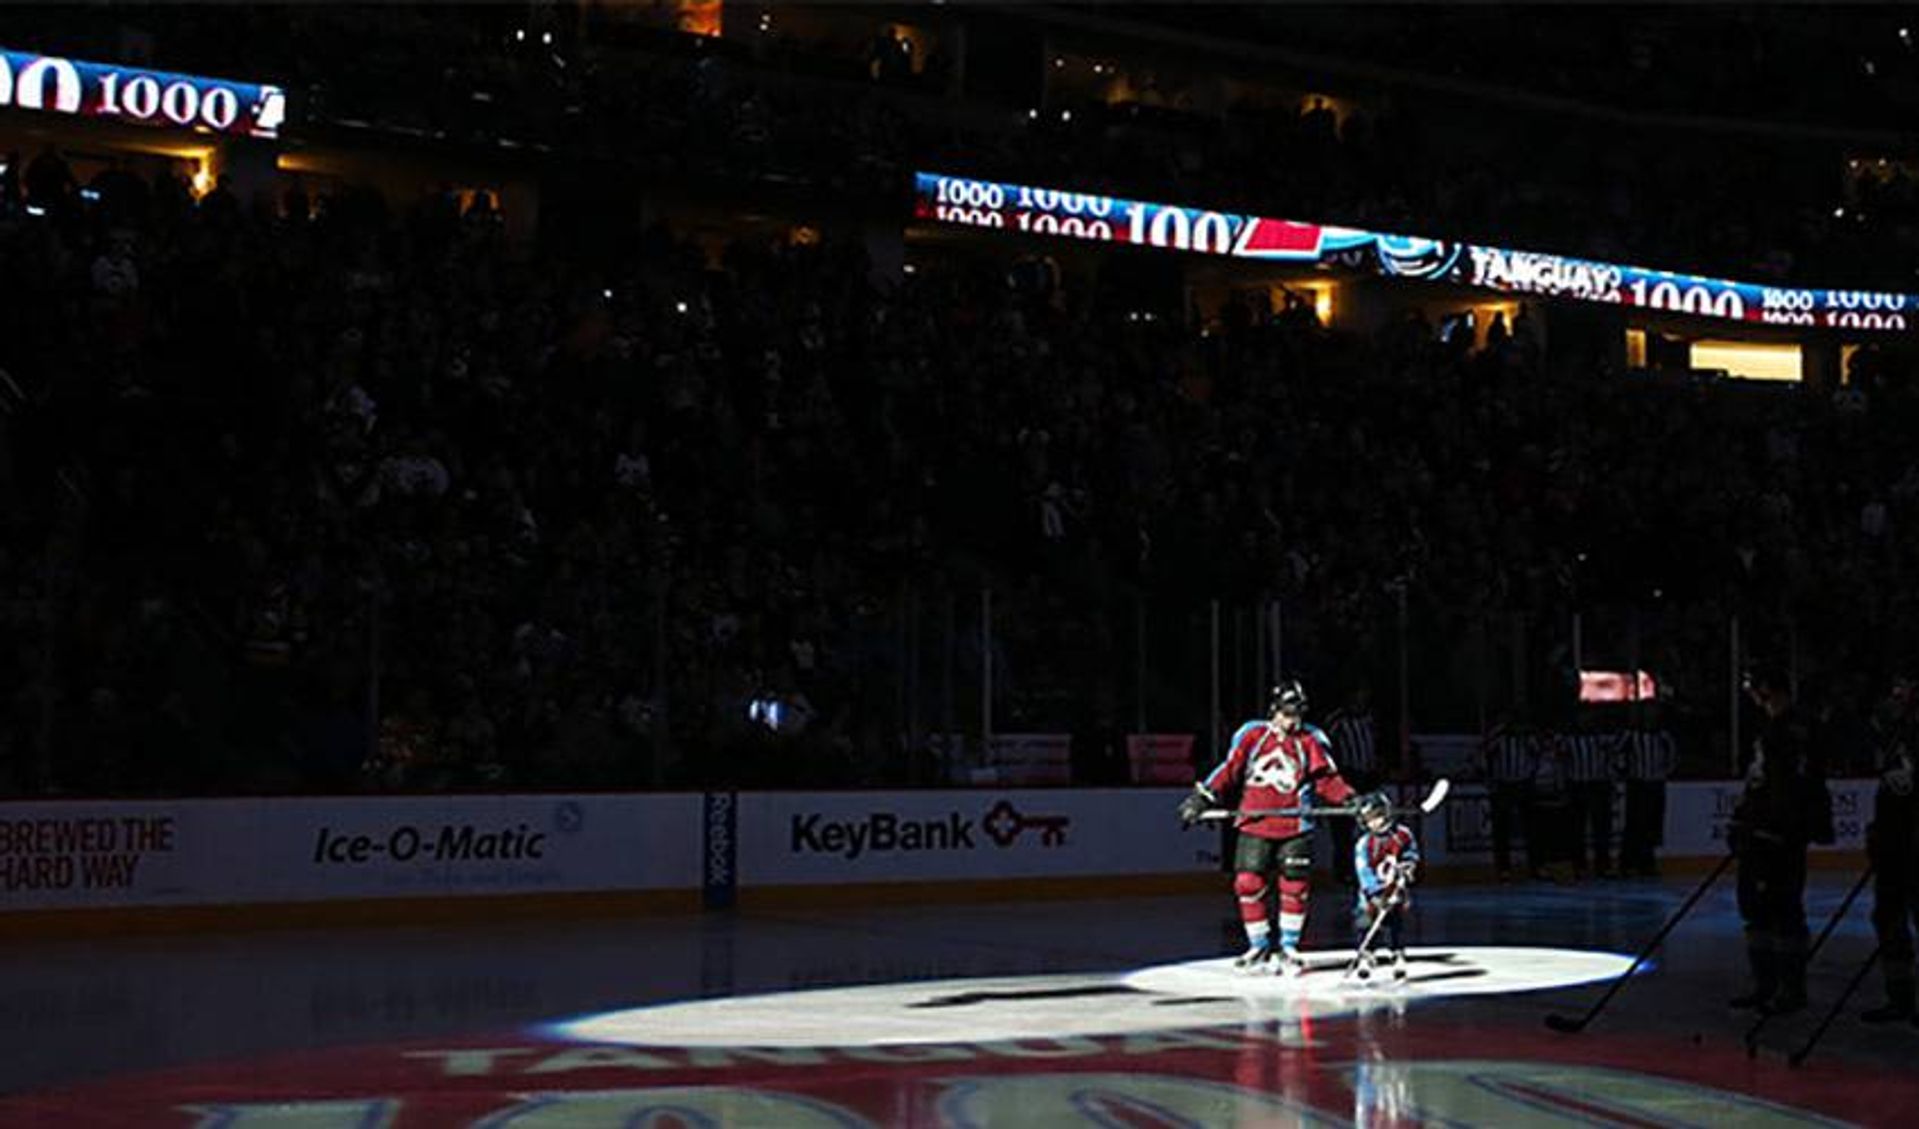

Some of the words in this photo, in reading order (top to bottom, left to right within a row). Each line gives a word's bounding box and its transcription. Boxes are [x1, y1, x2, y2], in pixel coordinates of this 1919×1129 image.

[97, 72, 238, 128] 1000
[937, 177, 1004, 208] 1000
[0, 818, 117, 854] BREWED
[122, 817, 174, 851] THE
[314, 823, 545, 863] Ice-O-Matic
[791, 811, 974, 859] KeyBank
[81, 855, 140, 889] WAY
